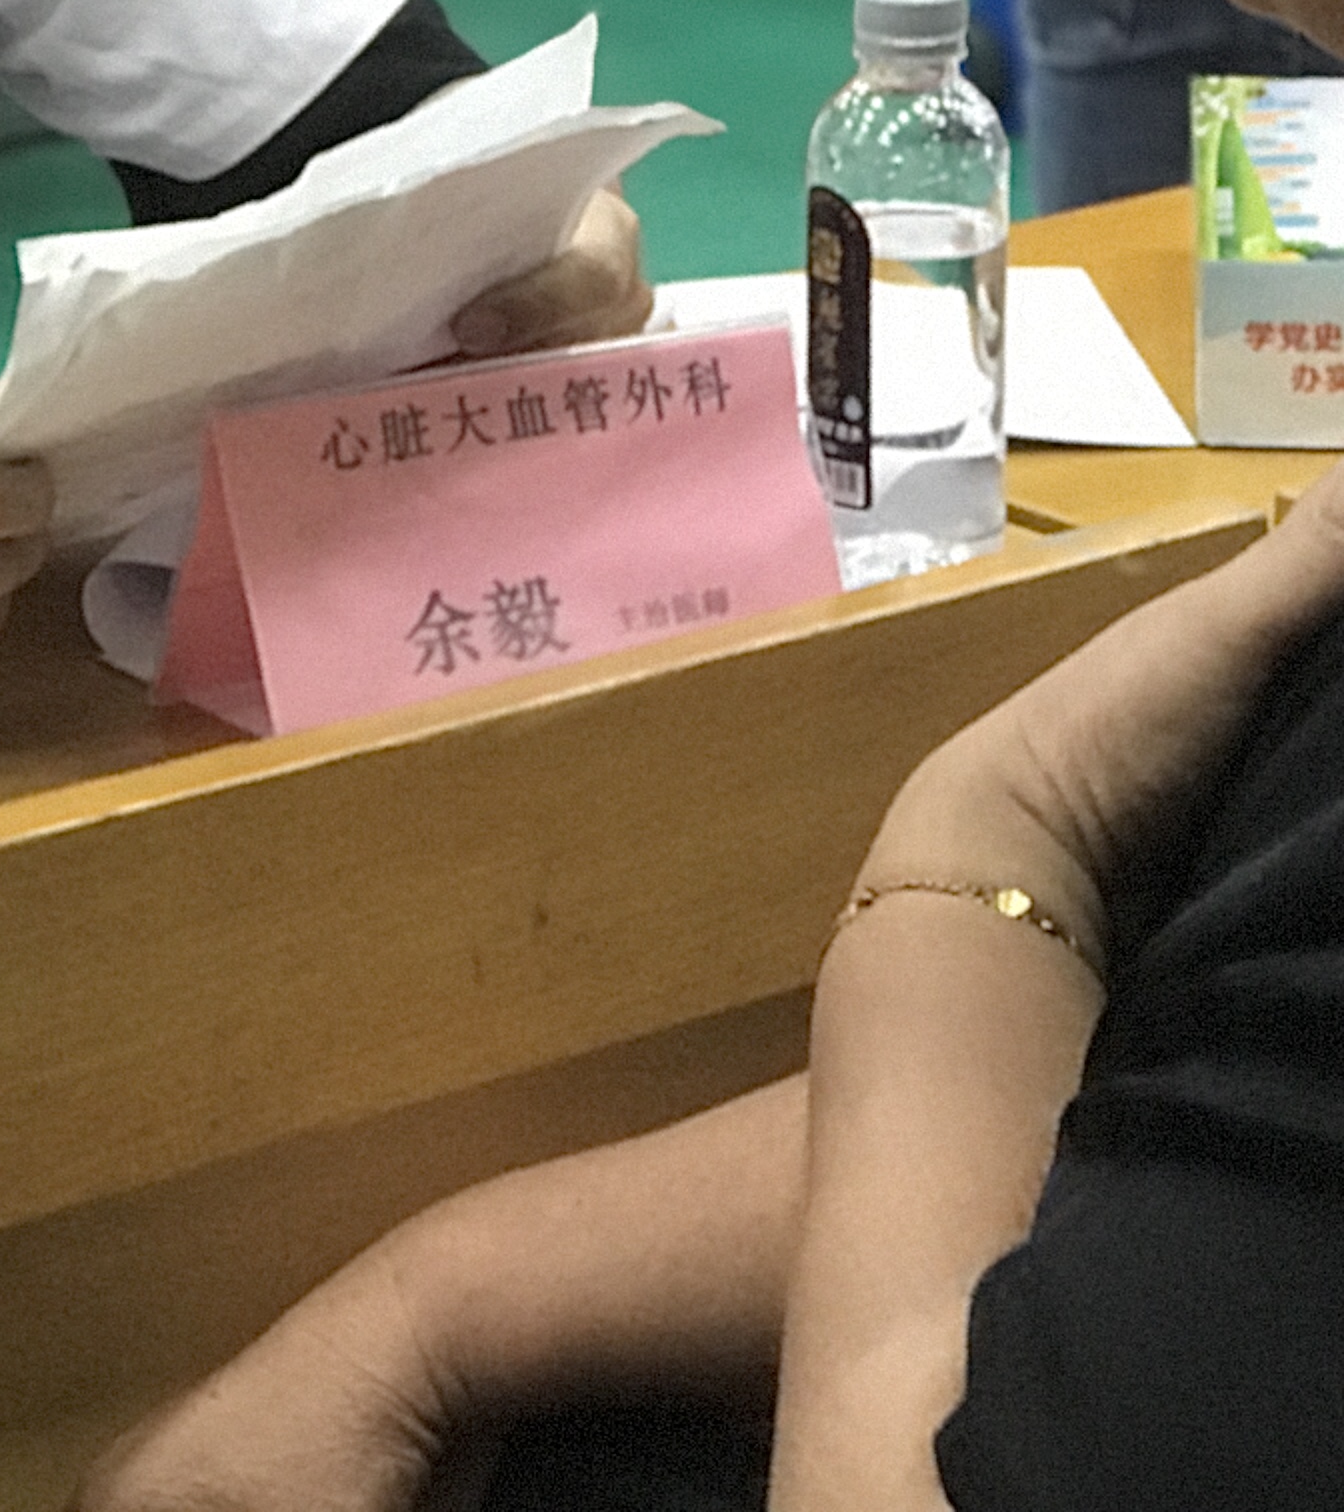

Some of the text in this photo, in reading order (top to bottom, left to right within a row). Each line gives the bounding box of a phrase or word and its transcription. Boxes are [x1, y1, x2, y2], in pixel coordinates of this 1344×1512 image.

[1243, 320, 1343, 353] 学党史
[320, 356, 732, 472] 心脏大血管外科
[404, 575, 573, 677] 余毅
